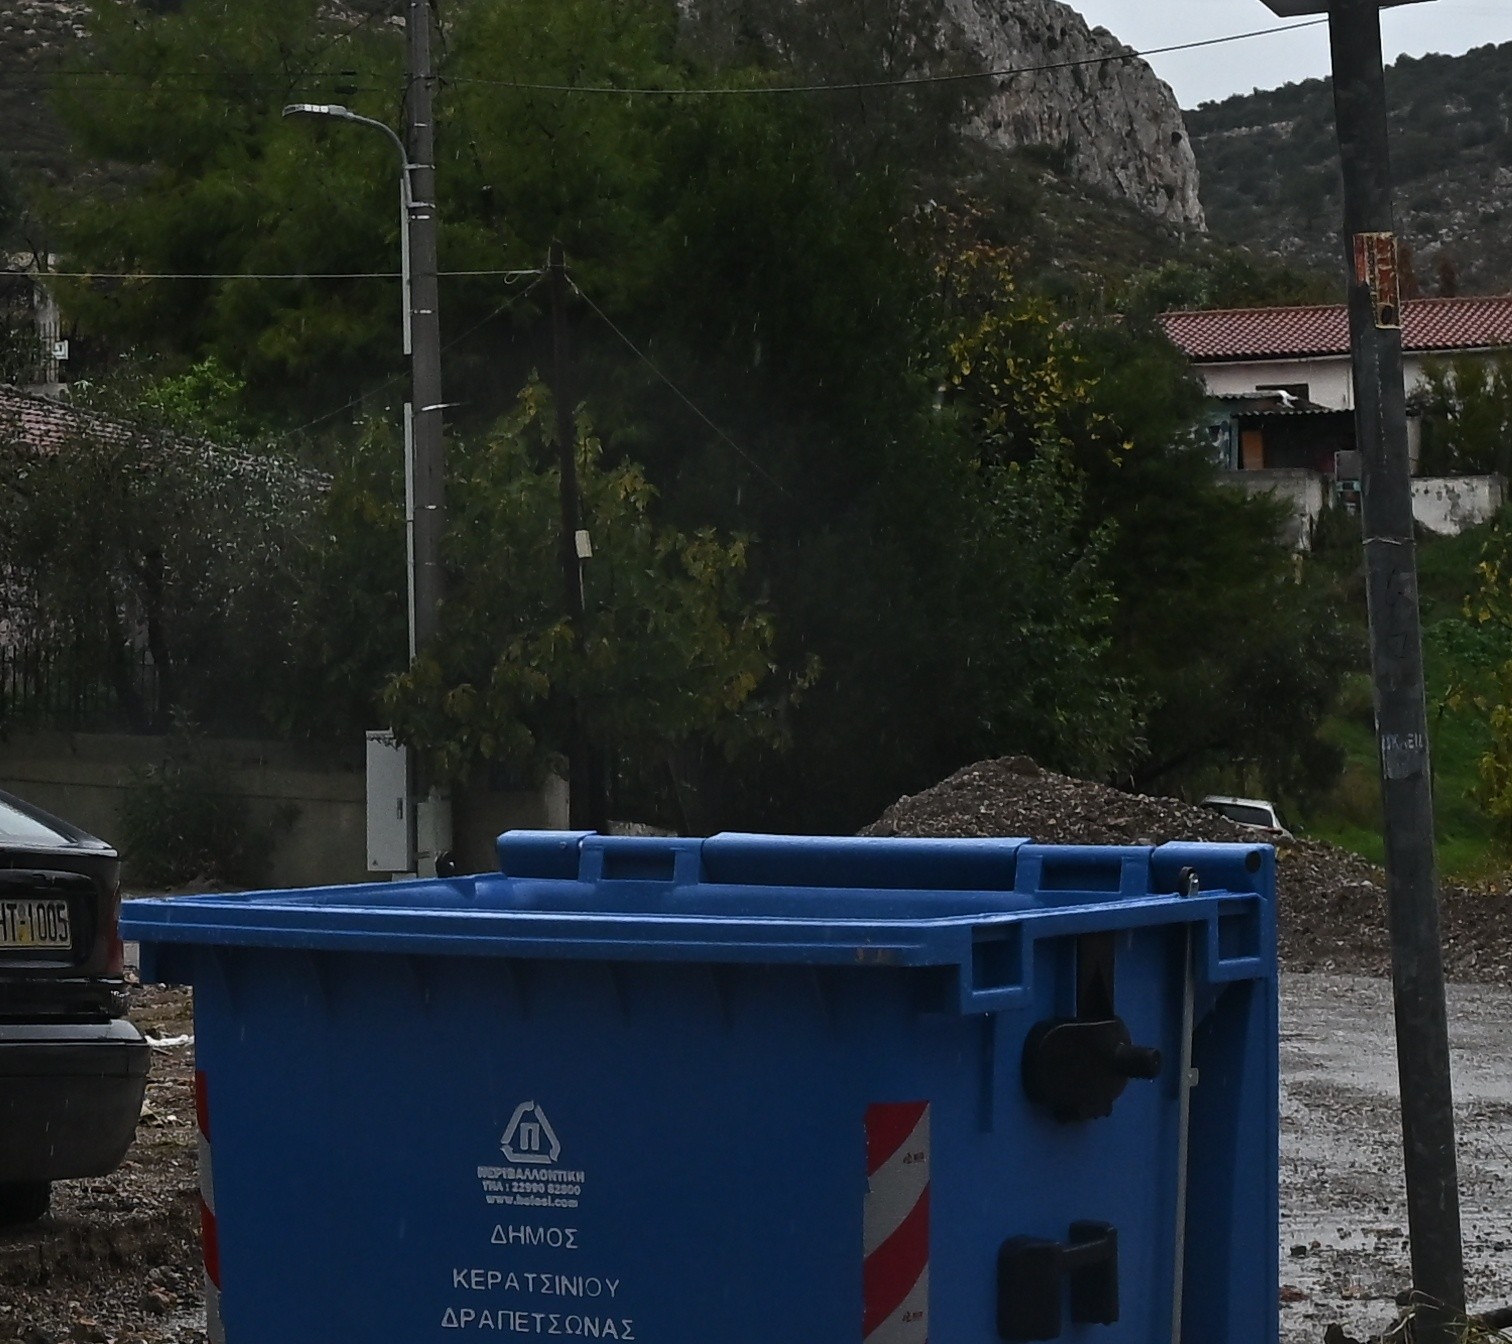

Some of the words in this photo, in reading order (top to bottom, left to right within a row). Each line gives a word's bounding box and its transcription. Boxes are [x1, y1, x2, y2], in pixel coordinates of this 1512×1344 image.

[477, 1166, 585, 1183] ΠΕΡΙΒΑΛΛΟΝΤΙΚΗ
[490, 1224, 579, 1249] ΔΗΜΟΣ
[453, 1268, 620, 1298] ΚΕΡΑΤΣΙΝΙΟΥ
[441, 1306, 636, 1341] ΔΡΑΠΕΤΣΩΝΑΣ
